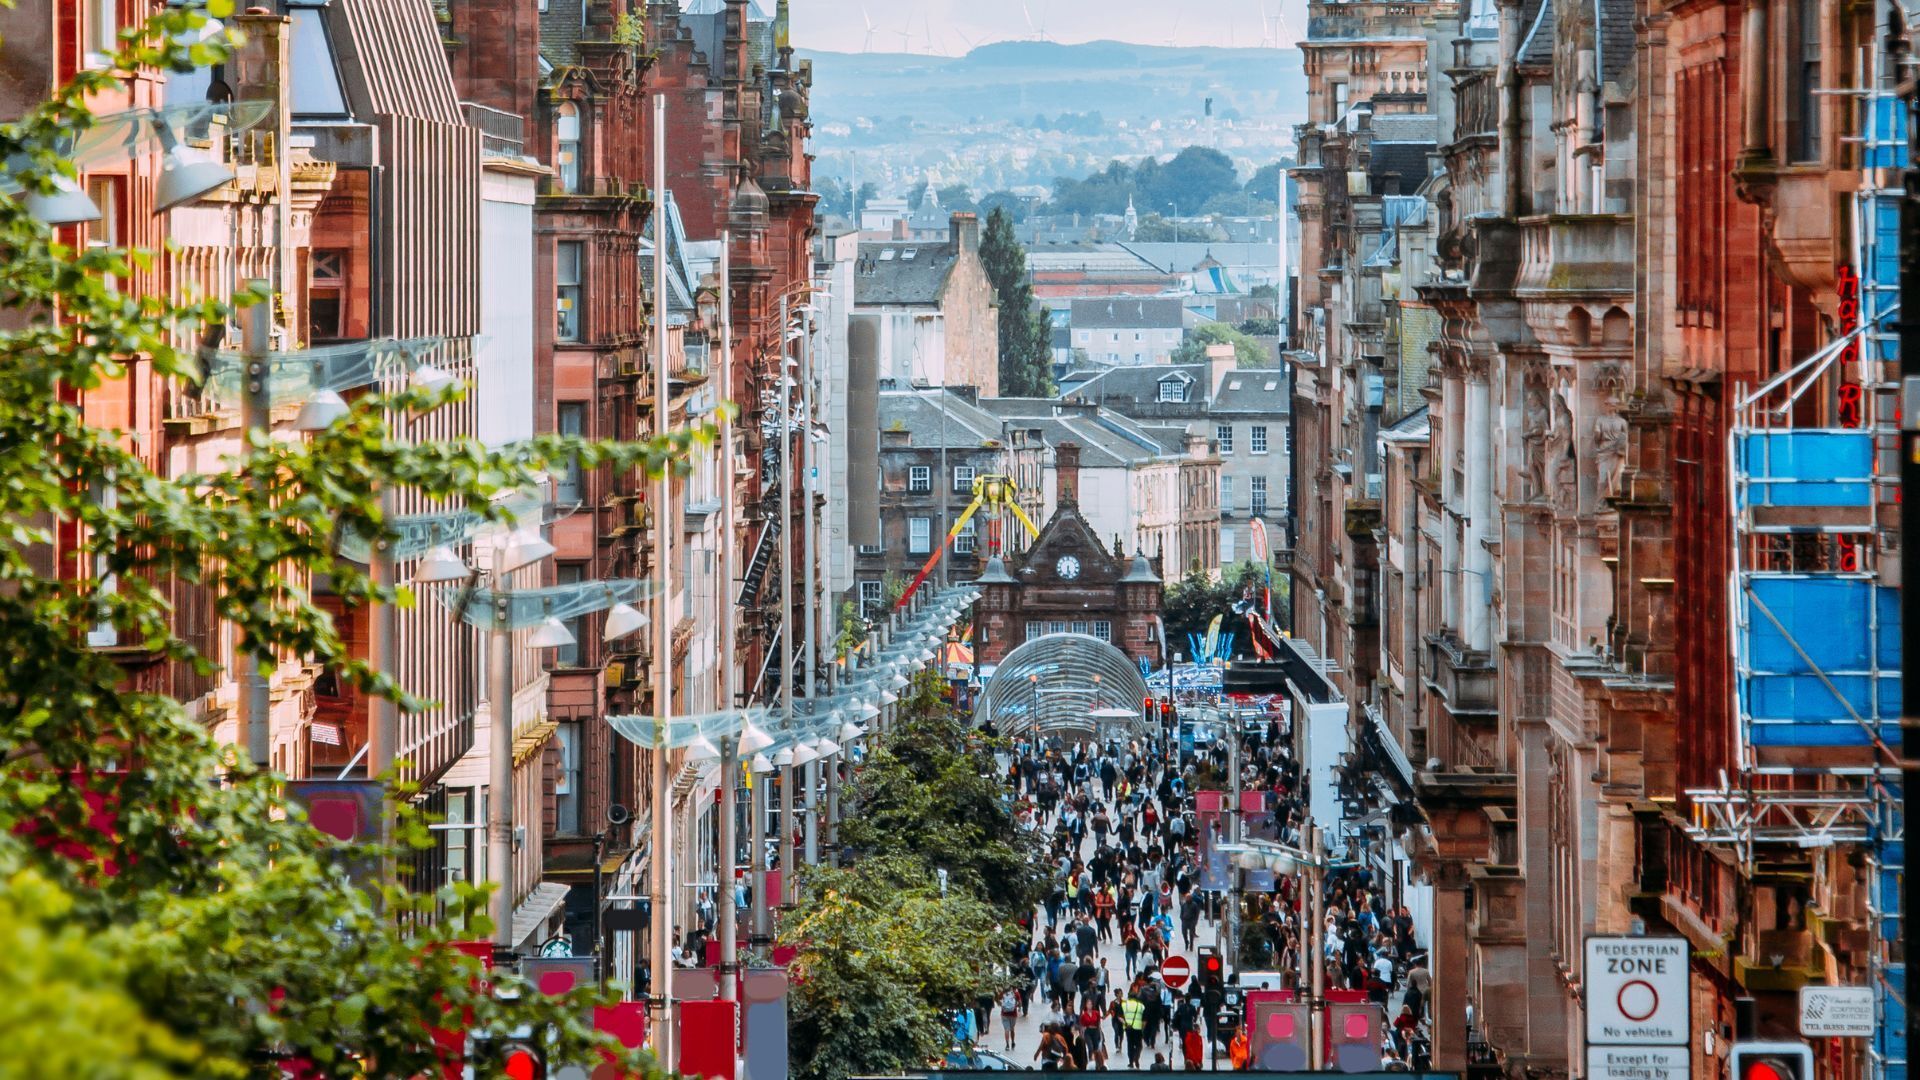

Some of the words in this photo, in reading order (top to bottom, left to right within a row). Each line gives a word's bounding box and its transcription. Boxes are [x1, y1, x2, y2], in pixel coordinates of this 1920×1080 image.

[1595, 944, 1679, 955] PEDESTRIAN
[1608, 958, 1667, 974] ZONE
[1604, 1027, 1621, 1037] No
[1625, 1027, 1673, 1038] vehicles
[1607, 1054, 1648, 1065] Except
[1652, 1054, 1669, 1065] for
[1608, 1067, 1651, 1078] loading
[1655, 1067, 1670, 1078] by
